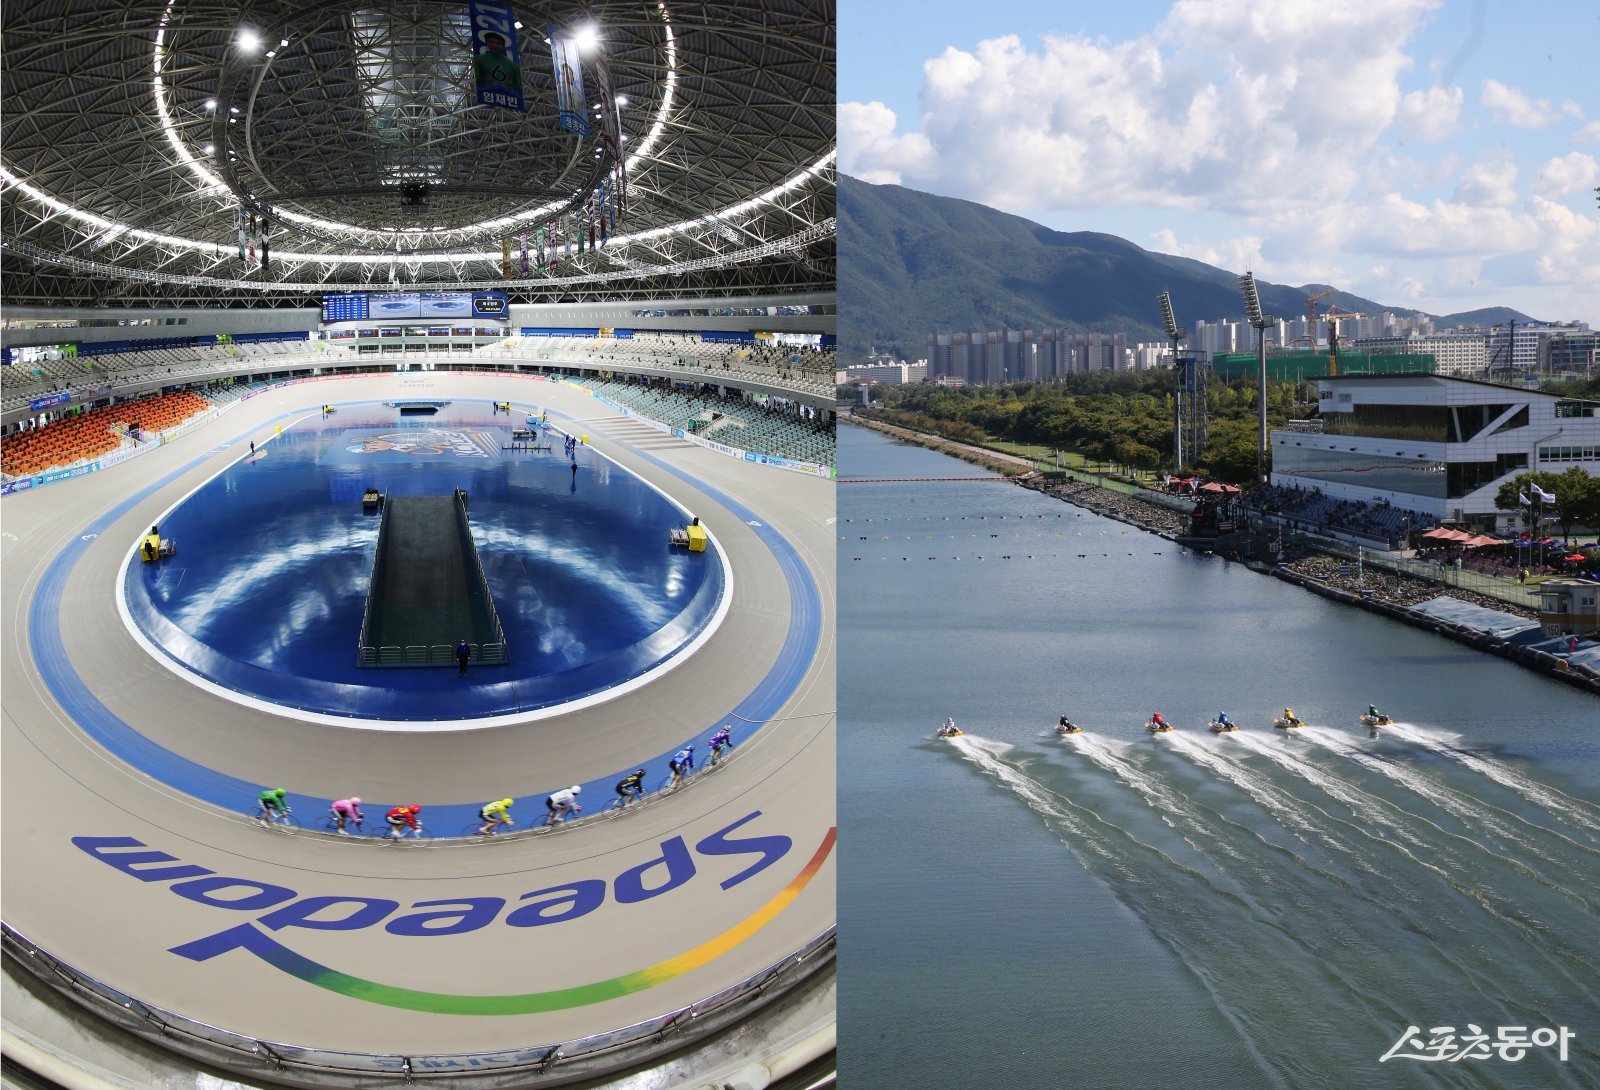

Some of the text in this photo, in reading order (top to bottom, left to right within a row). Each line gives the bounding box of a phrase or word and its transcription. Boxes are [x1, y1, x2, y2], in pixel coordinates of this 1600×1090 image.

[491, 64, 507, 82] 6
[483, 91, 518, 108] 임재빈
[1547, 624, 1560, 636] 150
[71, 810, 794, 963] Speedom
